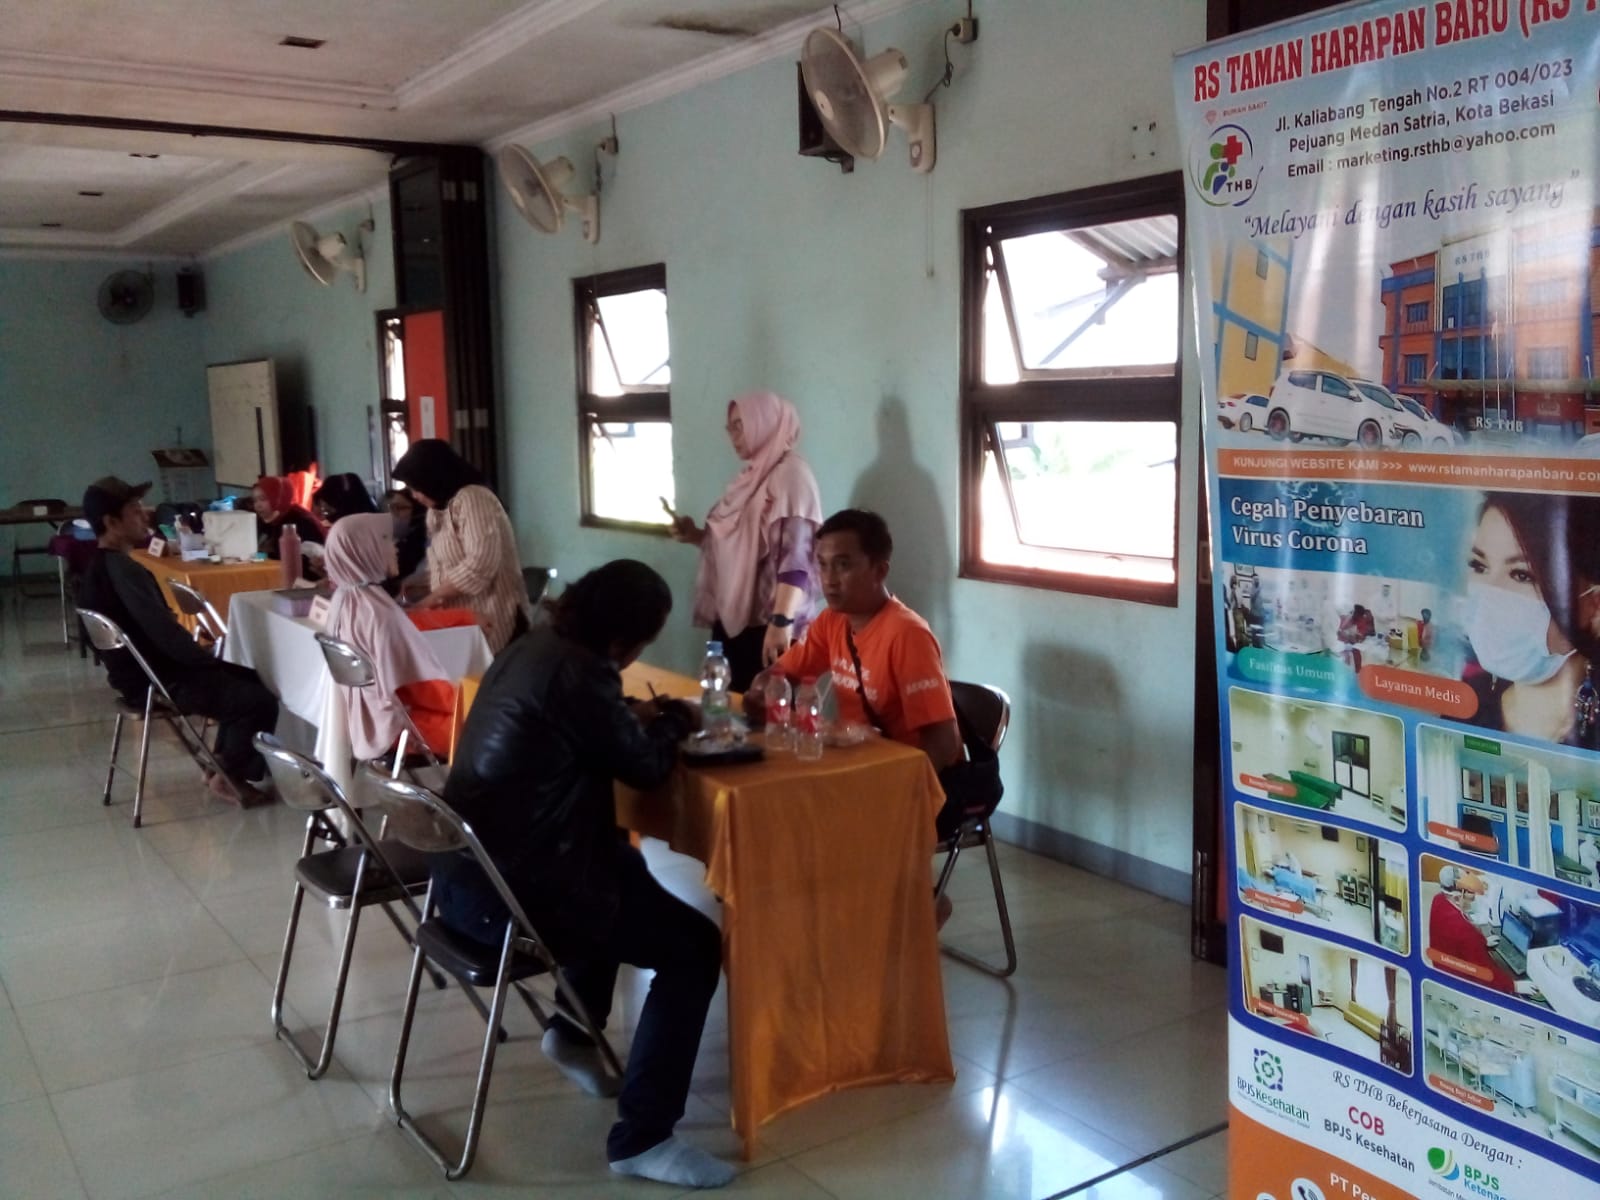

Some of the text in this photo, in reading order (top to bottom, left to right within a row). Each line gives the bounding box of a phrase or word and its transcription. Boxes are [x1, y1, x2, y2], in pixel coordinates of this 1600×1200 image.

[1195, 61, 1220, 102] RS
[1226, 38, 1303, 94] TAMAN
[1311, 7, 1425, 74] HARAPAN
[1435, 0, 1508, 46] BARU
[1275, 58, 1573, 132] Jl. Kaliabang Tengah No.2 RT 004/023
[1289, 89, 1554, 153] Pejuang Medan Satria, Kota Bekasi
[1288, 158, 1324, 177] Email
[1336, 122, 1556, 170] marketing.rsthb@yahoo.com
[1226, 179, 1253, 193] THB
[1244, 204, 1338, 239] “Melayai
[1345, 199, 1416, 229] dngan
[1423, 183, 1478, 220] kasih
[1233, 457, 1288, 469] KUNJUNGI
[1291, 458, 1344, 470] WEBSITE
[1349, 460, 1378, 471] KAMI
[1231, 496, 1424, 528] Cegah Penyebaran
[1232, 525, 1368, 554] Virus Corona
[1296, 664, 1335, 681] Umum
[1375, 675, 1461, 704] Layanan Medis
[1333, 1070, 1351, 1089] RS
[1353, 1078, 1383, 1101] THB
[1386, 1093, 1458, 1141] Bekerjasama
[1461, 1131, 1514, 1166] Dengan
[1349, 1105, 1385, 1136] COB
[1324, 1118, 1415, 1173] BPJS Kesehatan
[1330, 1172, 1349, 1193] PT
[1463, 1164, 1500, 1191] BPJS
